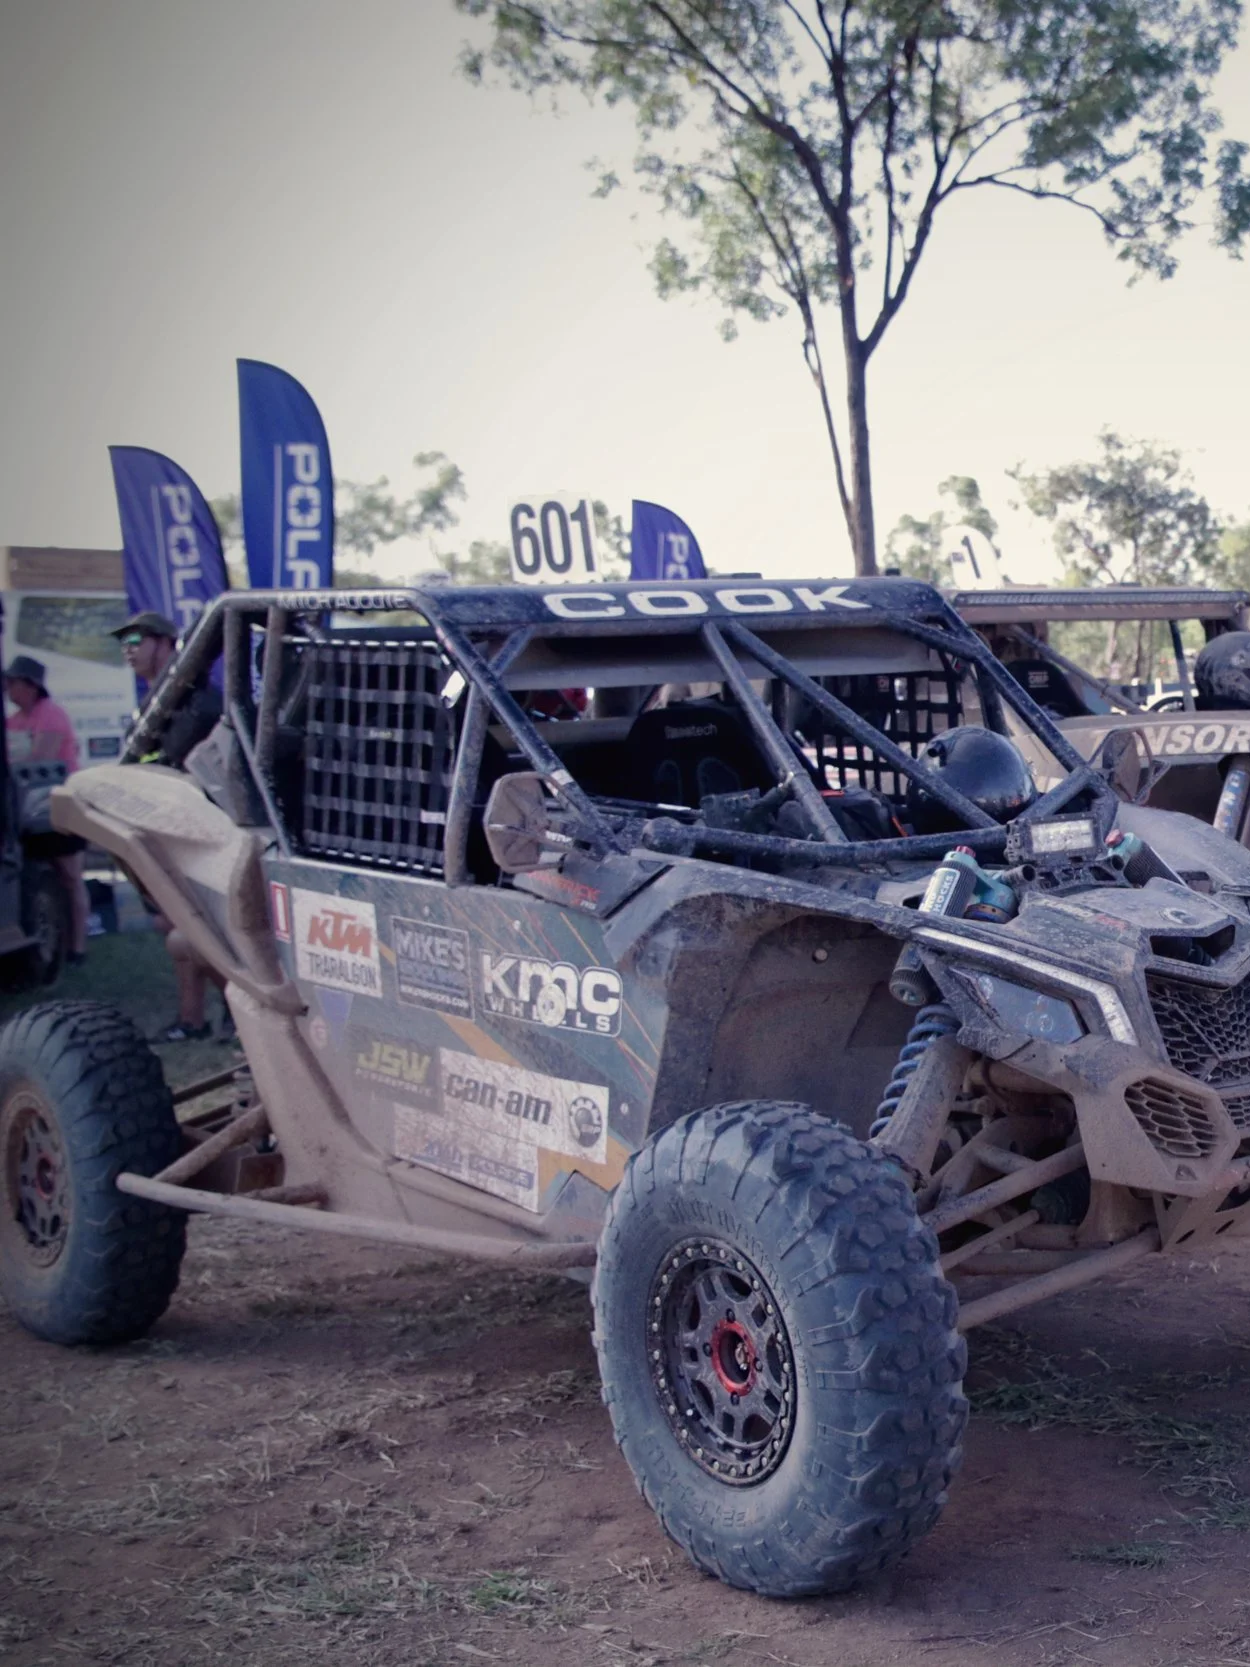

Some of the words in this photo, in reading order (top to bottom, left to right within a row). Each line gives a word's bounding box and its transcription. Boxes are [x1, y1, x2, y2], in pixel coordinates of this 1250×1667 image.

[510, 500, 596, 576] 601
[543, 586, 872, 618] COOK
[307, 908, 371, 957] KTM
[485, 991, 612, 1032] WHLS
[357, 1041, 431, 1083] JSW
[446, 1073, 552, 1125] can-am
